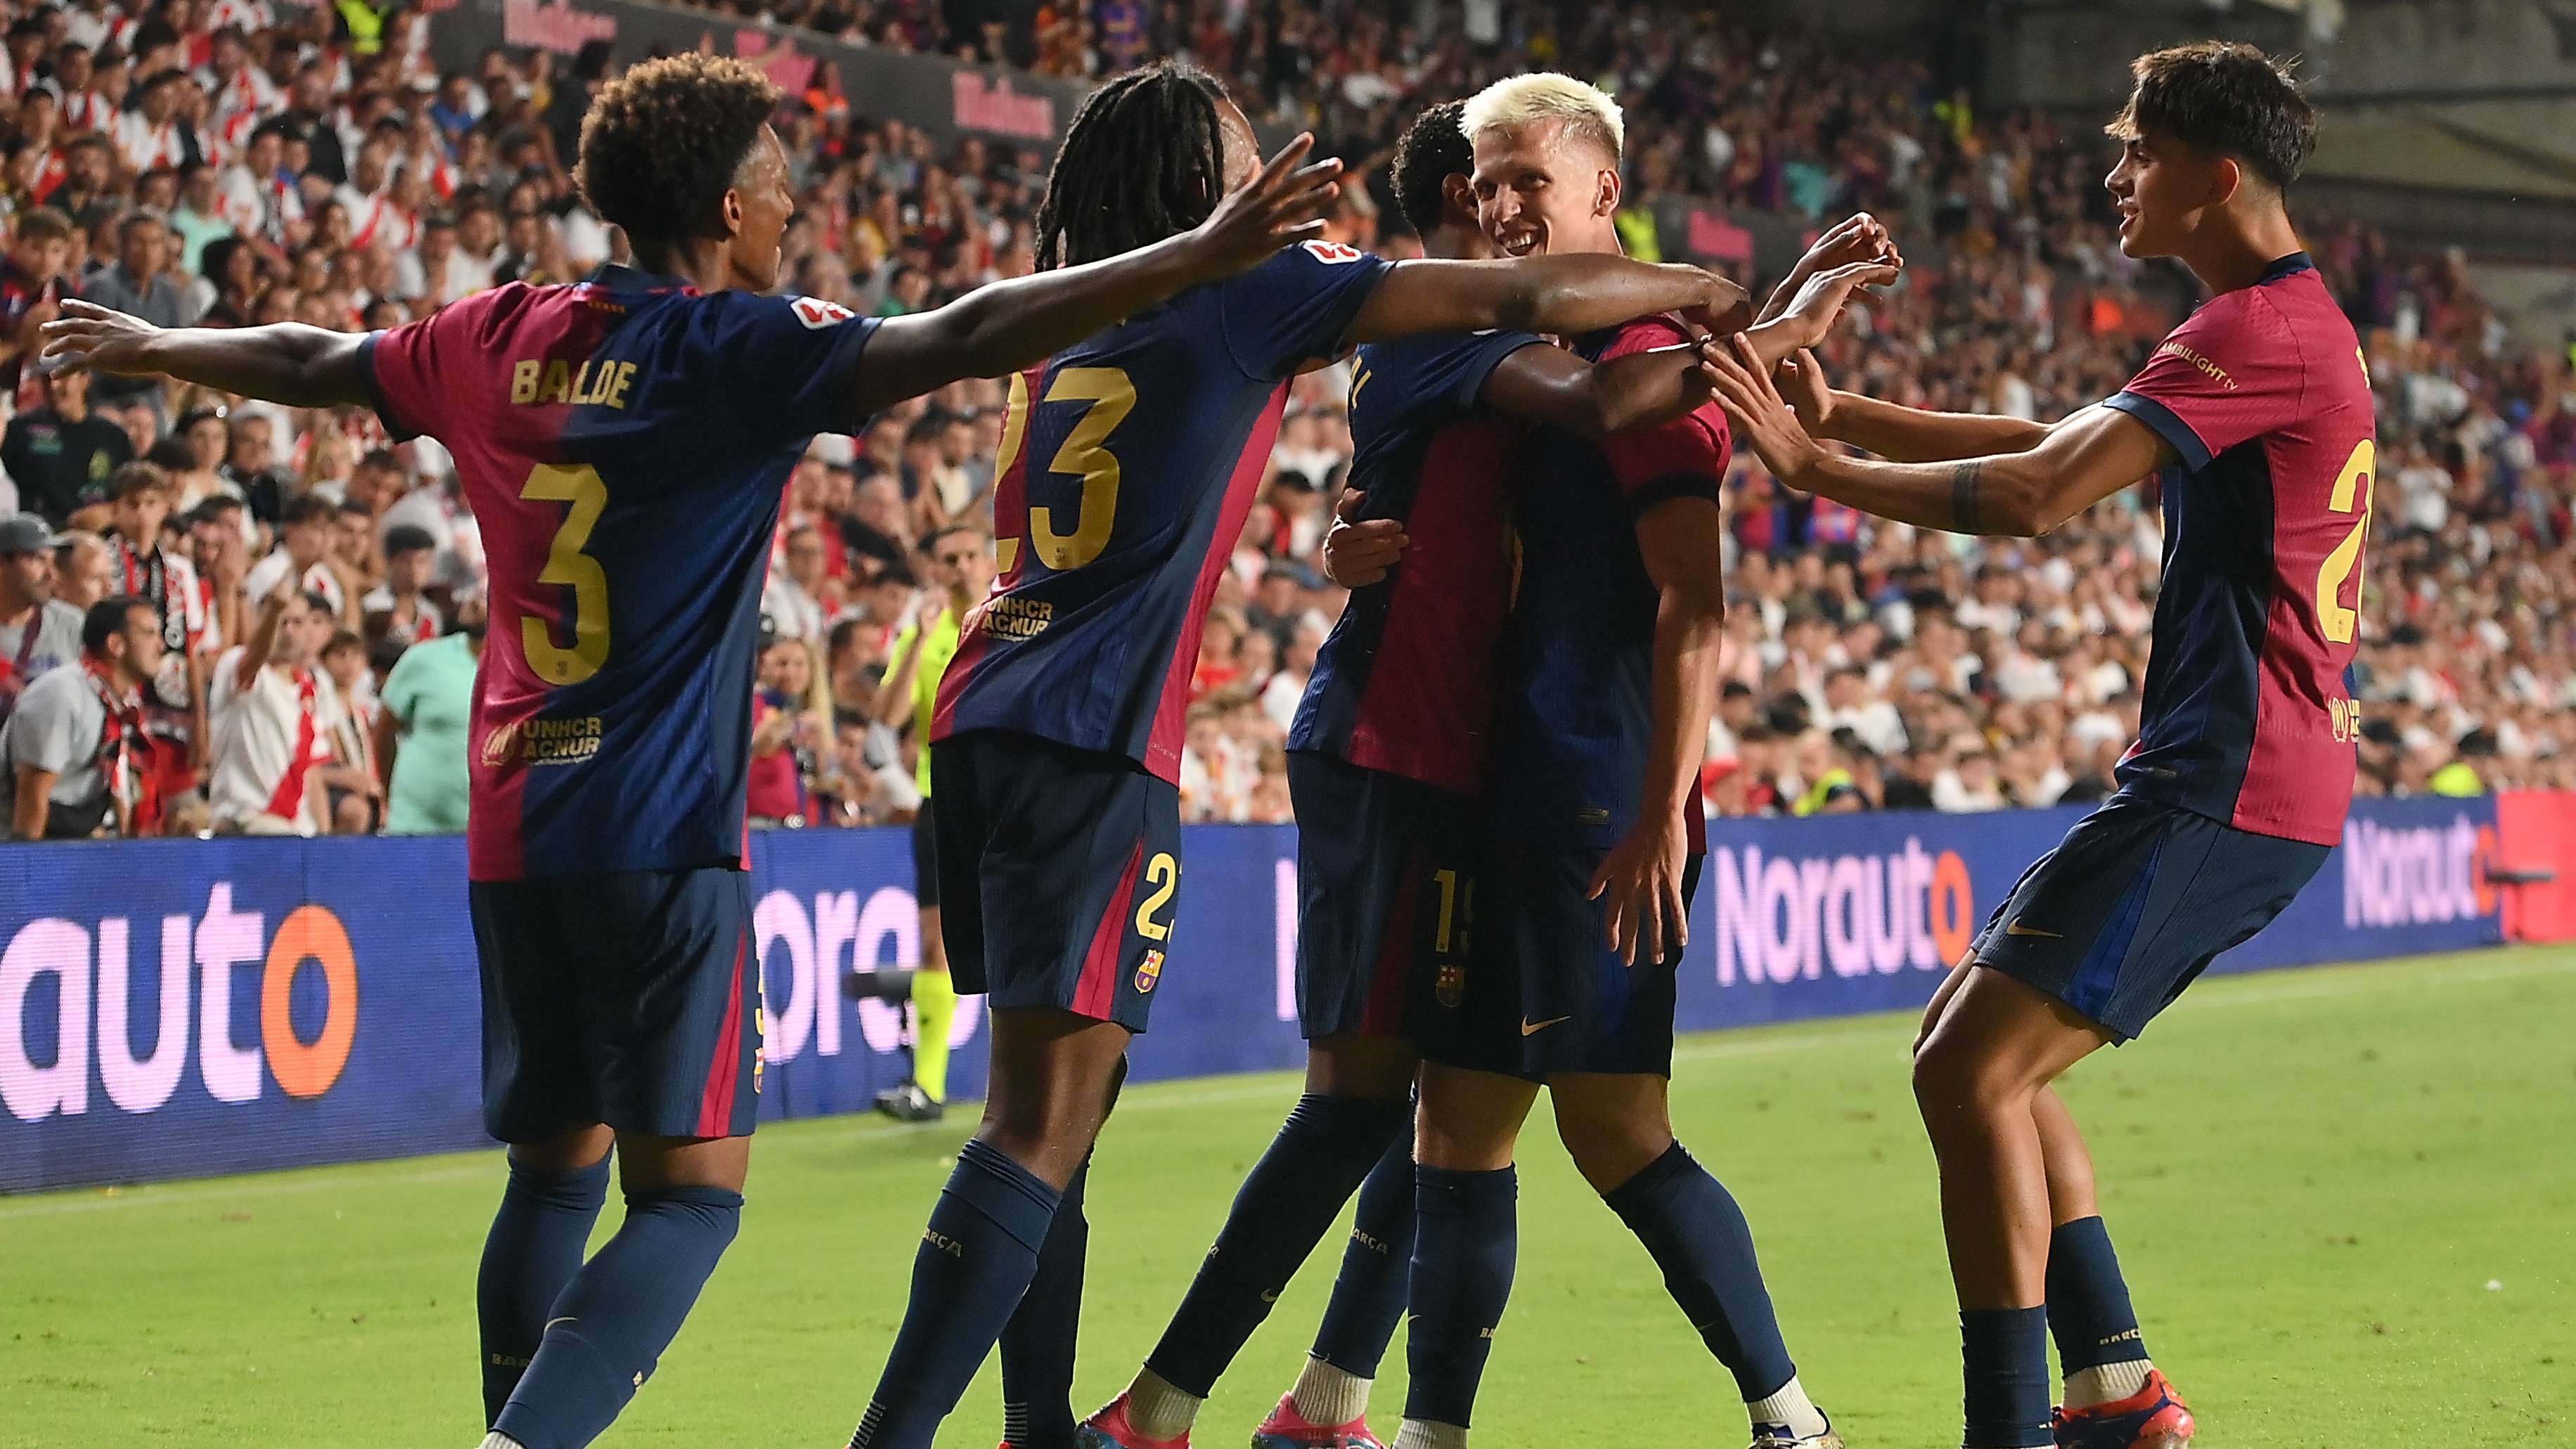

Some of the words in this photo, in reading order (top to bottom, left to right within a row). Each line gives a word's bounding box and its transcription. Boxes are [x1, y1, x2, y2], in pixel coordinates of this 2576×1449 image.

[510, 359, 638, 411] BALDE
[2158, 341, 2227, 381] AMBILIGHT
[518, 463, 610, 686] 3
[2317, 438, 2376, 645] 2
[522, 716, 601, 738] UNHCR
[522, 737, 601, 759] ACNUR
[1135, 852, 1183, 944] 2
[1714, 835, 1973, 987] Norauto
[2343, 812, 2497, 929] Norauto
[0, 880, 359, 1121] auto
